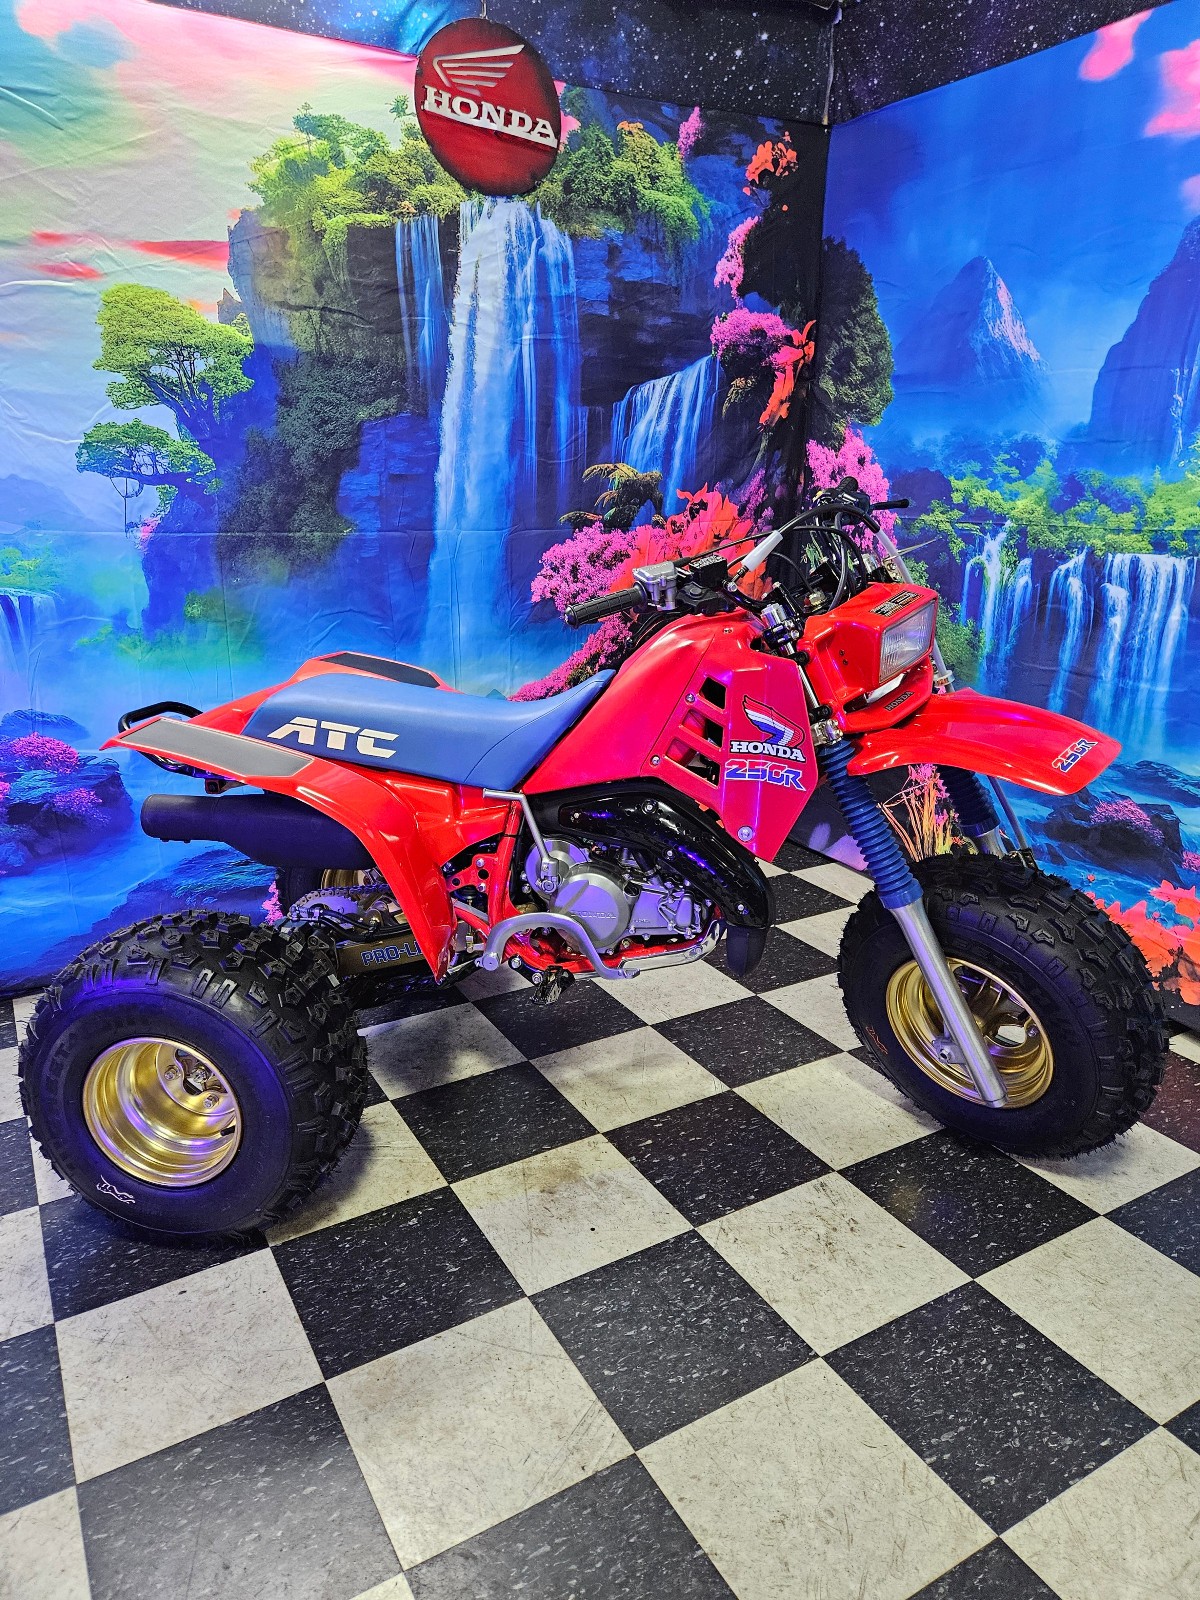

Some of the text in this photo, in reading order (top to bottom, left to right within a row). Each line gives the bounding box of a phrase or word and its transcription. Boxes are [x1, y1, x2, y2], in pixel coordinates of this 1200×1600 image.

[421, 85, 557, 148] HONDA
[885, 691, 914, 711] HONDA
[267, 716, 399, 758] ATC
[730, 741, 806, 762] HONDA
[1052, 738, 1098, 772] 250R
[725, 759, 806, 791] 250R
[361, 940, 424, 966] PRO-LI
